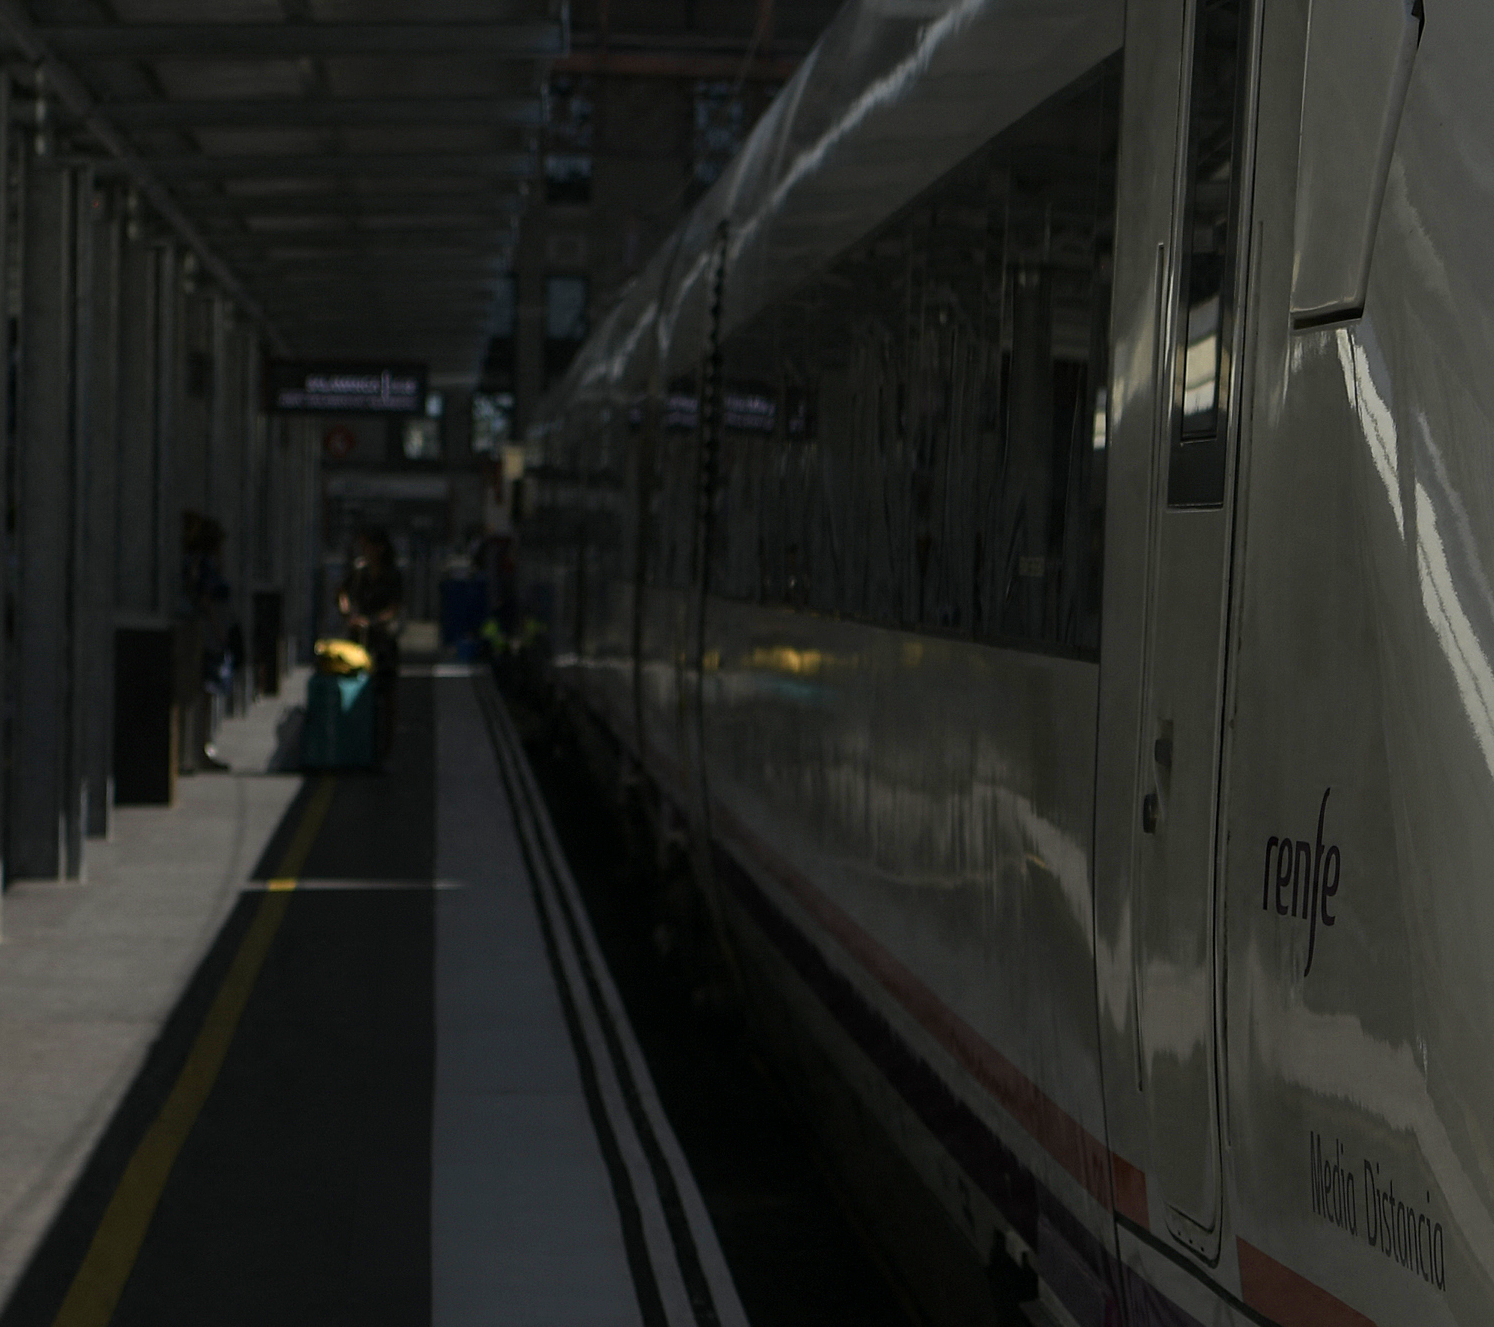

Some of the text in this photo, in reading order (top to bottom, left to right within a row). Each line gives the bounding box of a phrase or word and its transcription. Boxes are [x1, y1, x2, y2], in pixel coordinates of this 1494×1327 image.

[1262, 787, 1341, 977] renfe
[1310, 1130, 1446, 1292] Media Distancia
